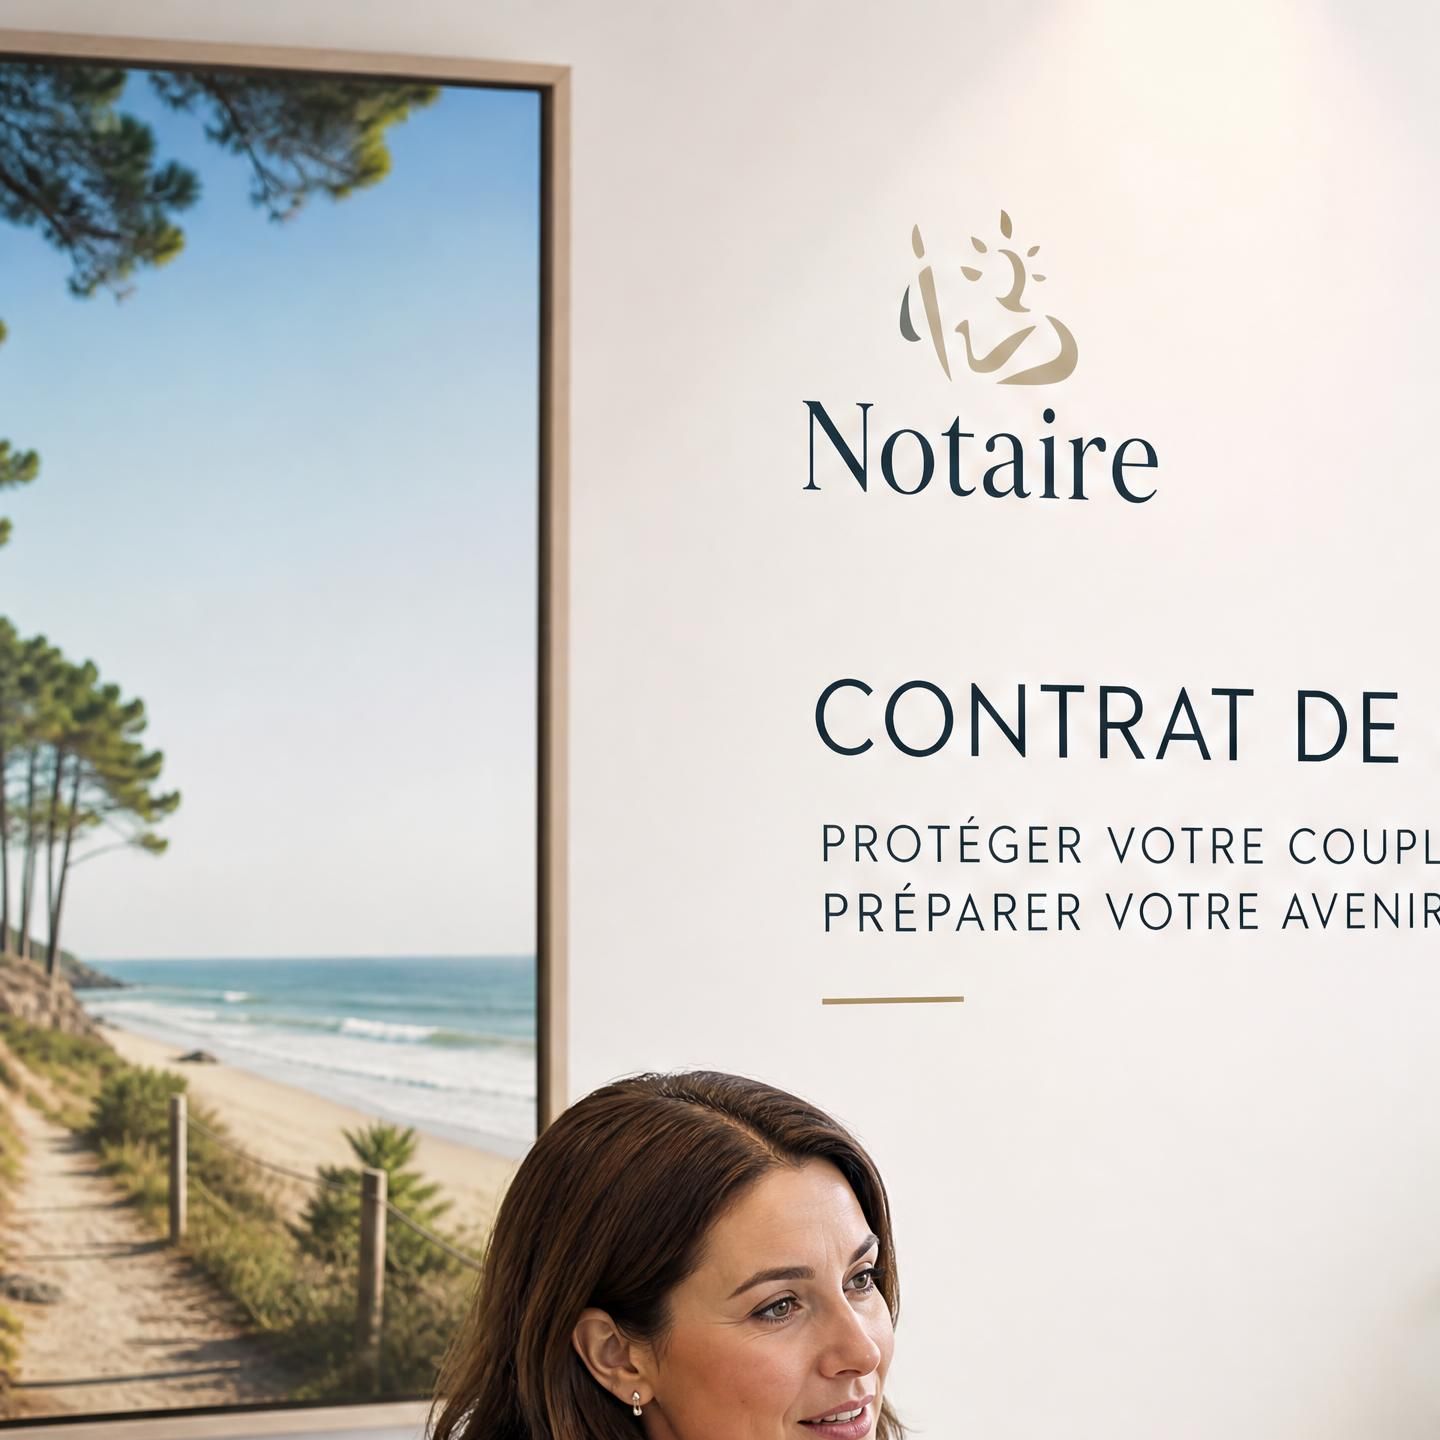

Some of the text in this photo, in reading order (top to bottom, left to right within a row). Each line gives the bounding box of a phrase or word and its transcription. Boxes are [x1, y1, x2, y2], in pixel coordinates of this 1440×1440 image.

[802, 400, 1159, 504] Notaire
[815, 678, 1255, 761] CONTRAT
[1297, 689, 1399, 764] DE
[823, 815, 1081, 864] PROTÉGER
[1107, 826, 1264, 865] VOTRE
[824, 882, 1081, 933] PRÉPARER
[1105, 892, 1259, 931] VOTRE
